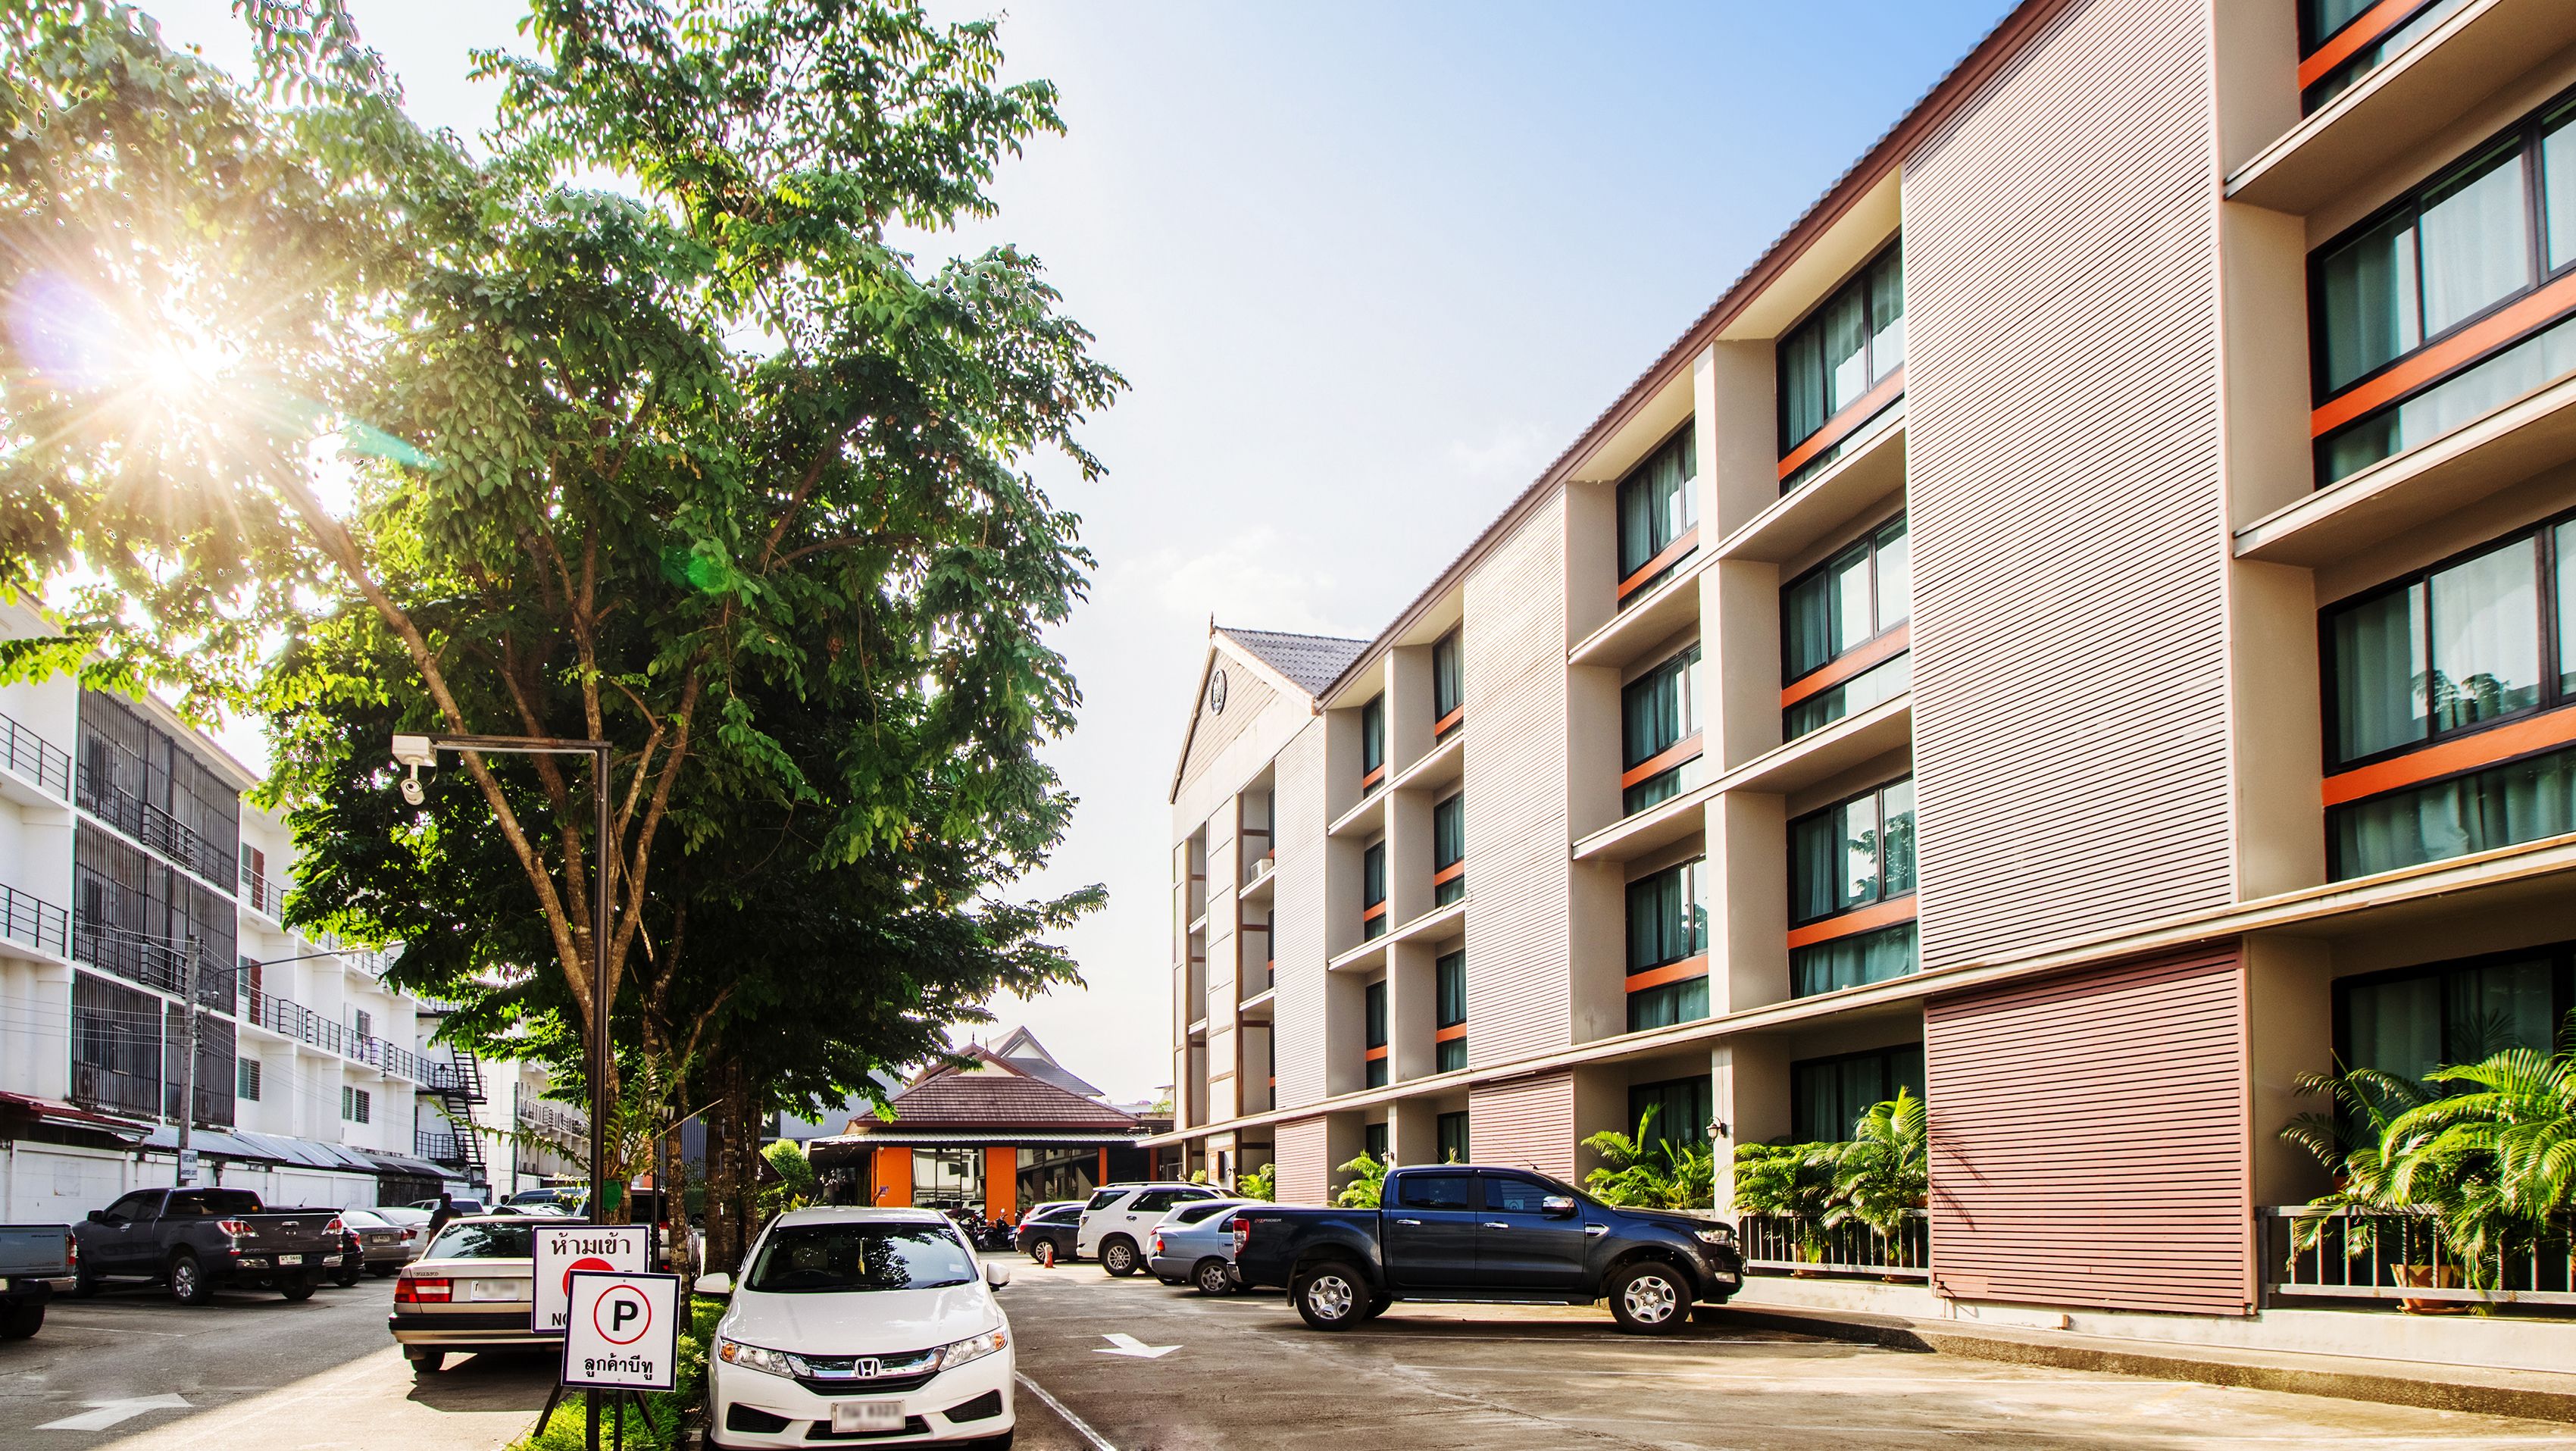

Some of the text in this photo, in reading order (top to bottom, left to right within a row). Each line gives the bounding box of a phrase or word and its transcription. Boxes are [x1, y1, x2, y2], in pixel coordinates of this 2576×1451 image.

[551, 1232, 630, 1256] ห้ามเข้า
[613, 1299, 639, 1332] P
[584, 1352, 654, 1381] ลูกค้าบีทู
